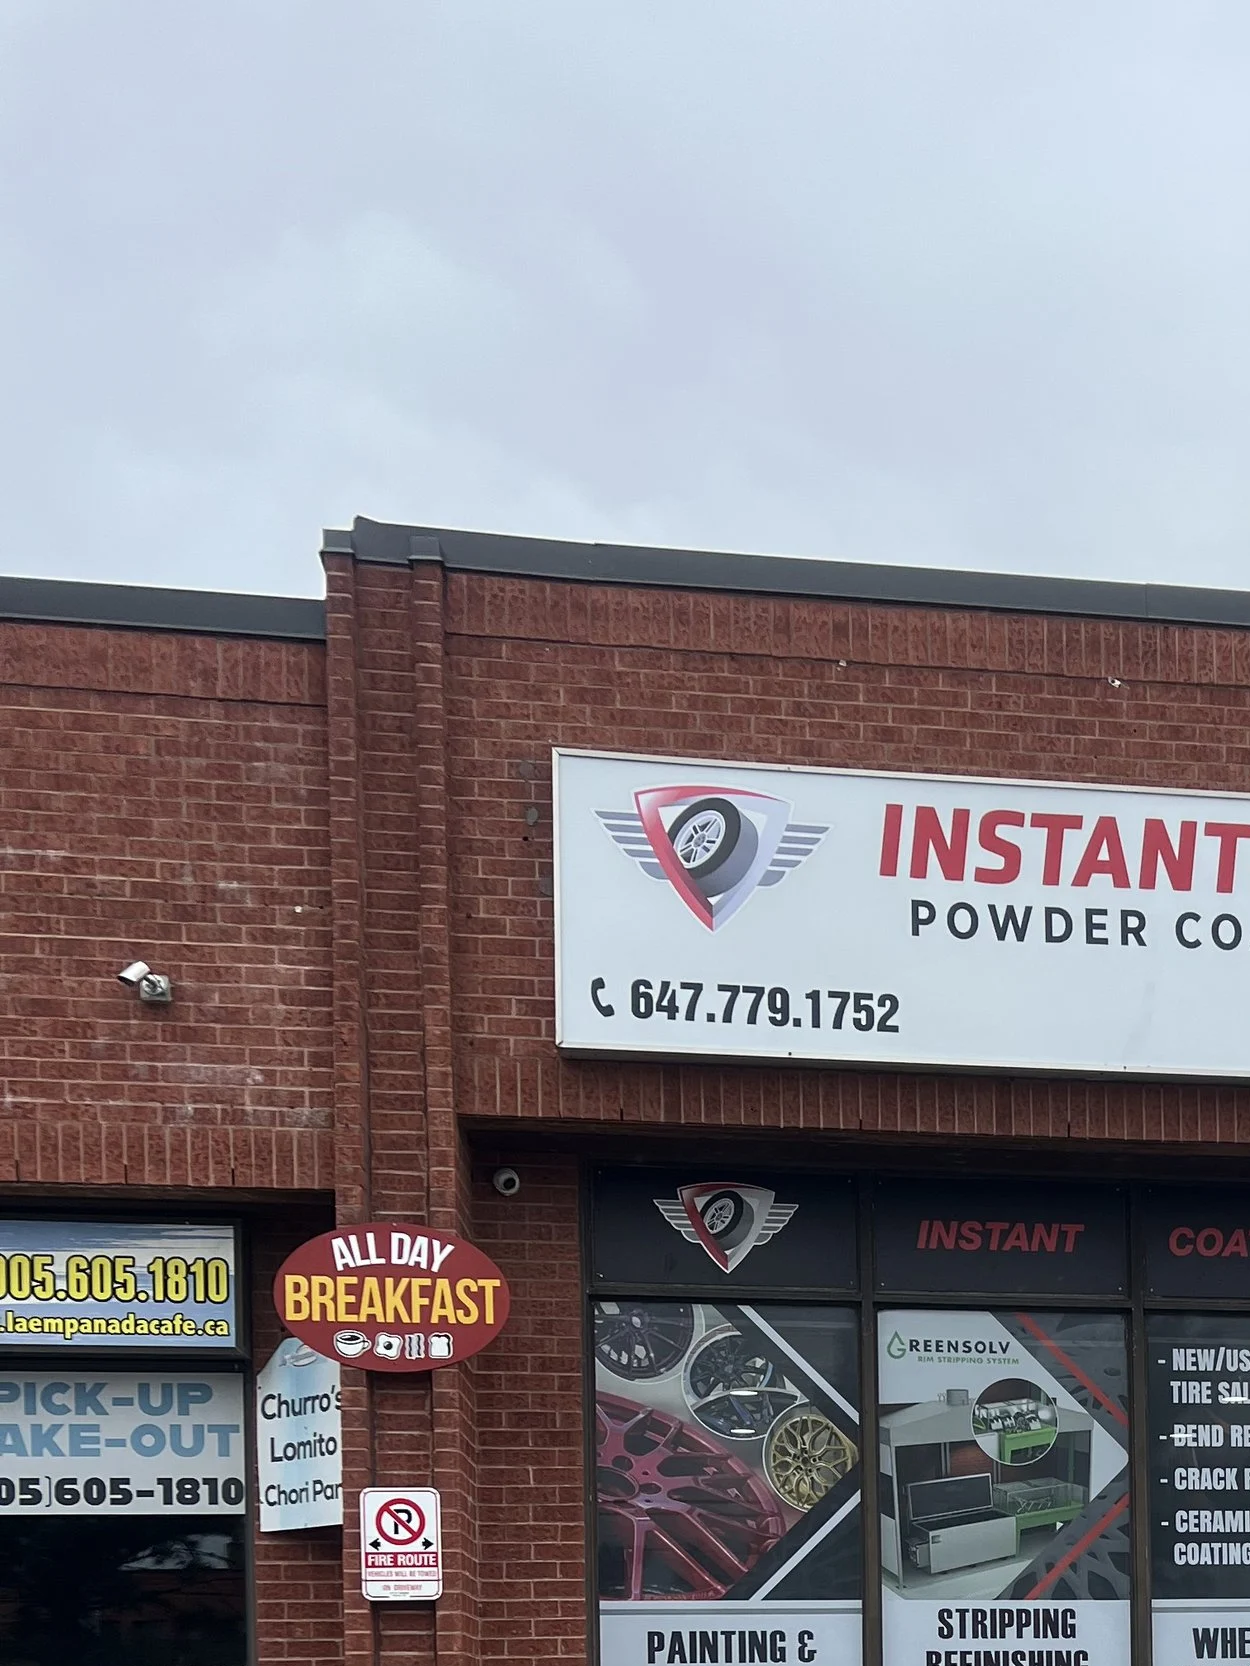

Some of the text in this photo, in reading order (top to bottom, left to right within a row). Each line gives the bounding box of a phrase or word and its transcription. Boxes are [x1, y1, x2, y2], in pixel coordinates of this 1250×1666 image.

[910, 899, 1147, 946] POWDER
[630, 978, 900, 1033] 647.779.1752
[916, 1220, 1084, 1253] INSTANT
[331, 1232, 455, 1273] ALL DAY
[284, 1273, 501, 1325] BREAKFAST
[918, 1355, 1019, 1365] RIM STRIPPING SYSTEM
[1170, 1380, 1212, 1404] TIRE
[270, 1432, 337, 1463] Lomito
[1173, 1424, 1224, 1447] BEND
[264, 1481, 309, 1507] Chori
[1174, 1467, 1238, 1490] CRACK
[367, 1553, 437, 1567] FIRE ROUTE
[937, 1608, 1077, 1640] STRIPPING
[647, 1630, 817, 1664] PAINTING &
